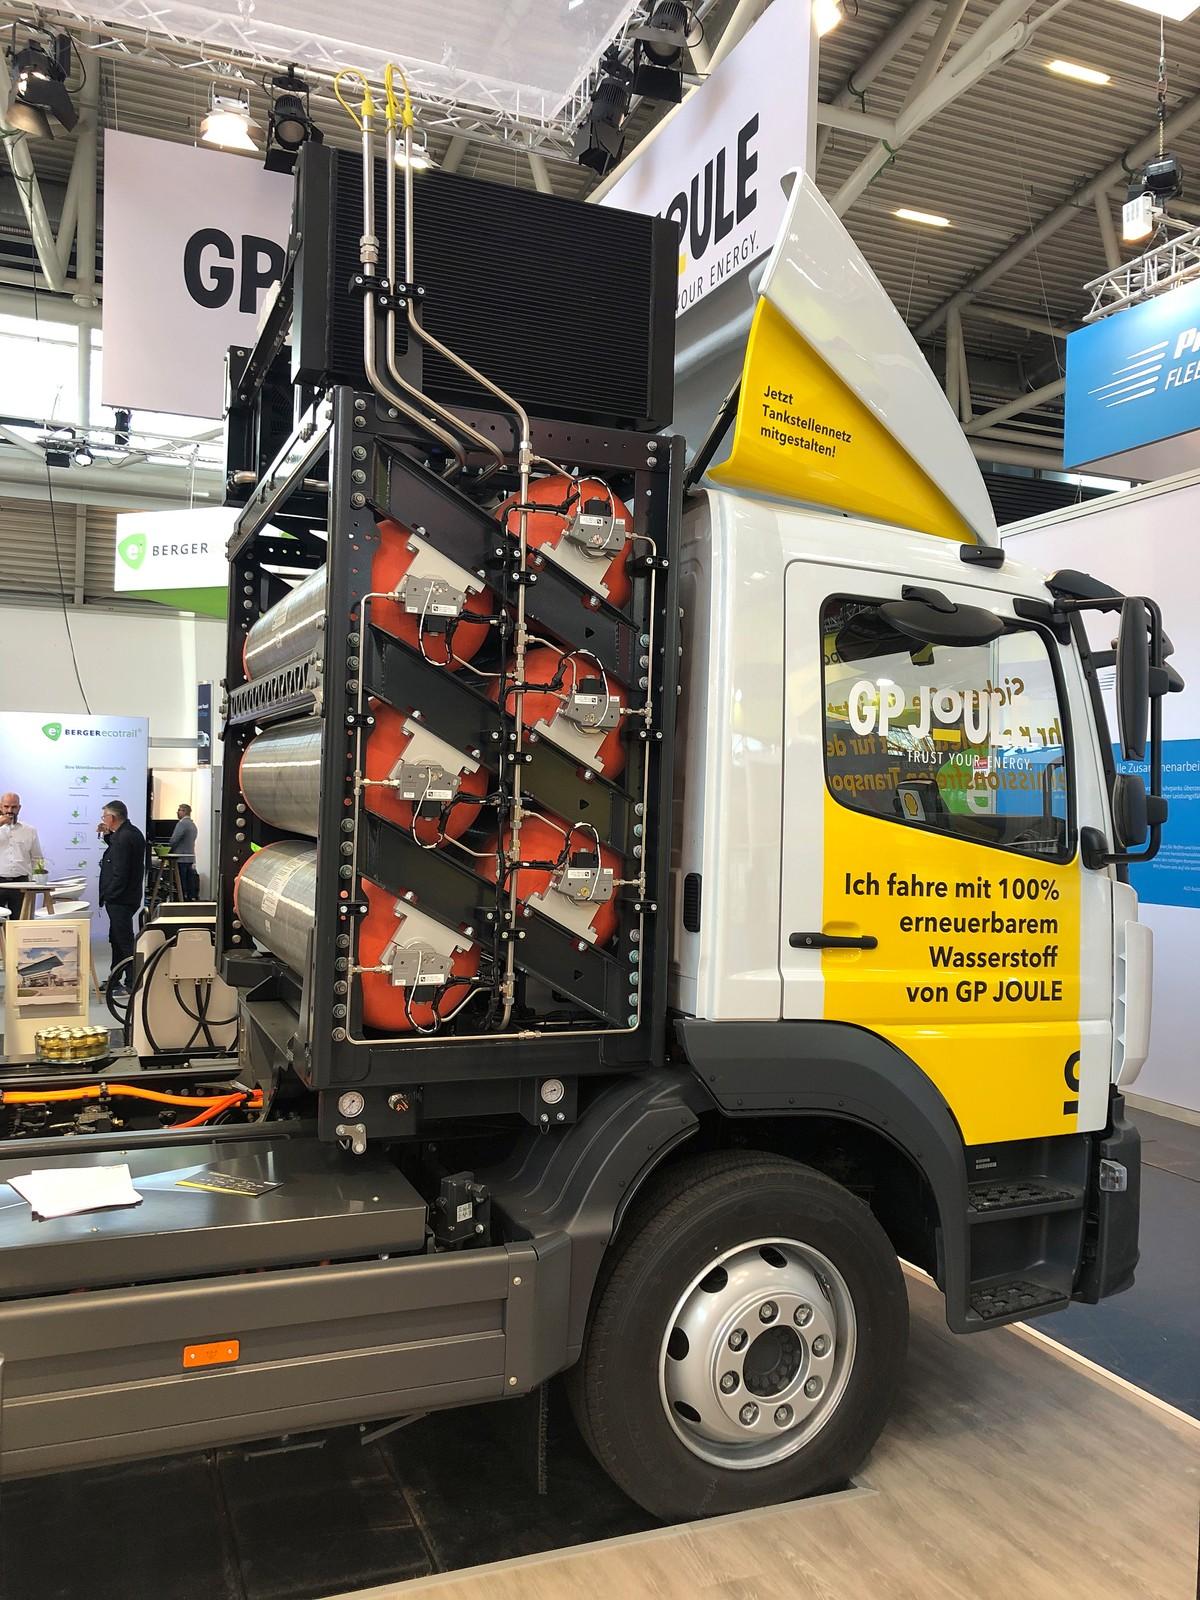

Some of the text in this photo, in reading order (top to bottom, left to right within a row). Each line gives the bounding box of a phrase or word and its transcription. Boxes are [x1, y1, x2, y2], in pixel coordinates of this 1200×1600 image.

[656, 112, 759, 260] OULE
[183, 227, 286, 314] GP
[710, 230, 759, 287] ENERGY.
[763, 385, 794, 405] Jetzt
[762, 404, 852, 443] Tankstellennetz
[760, 426, 836, 458] mitgestalten!
[152, 542, 208, 556] BERGER
[848, 680, 905, 737] GP
[907, 749, 943, 764] TRUST
[949, 752, 980, 767] YOUR
[988, 755, 1033, 771] ENERGY.
[845, 872, 1060, 901] Ich fahre mit 100%
[899, 911, 1058, 934] erneuerbarem
[929, 945, 1058, 968] Wasserstoff
[906, 980, 1063, 1003] von GP JOULE
